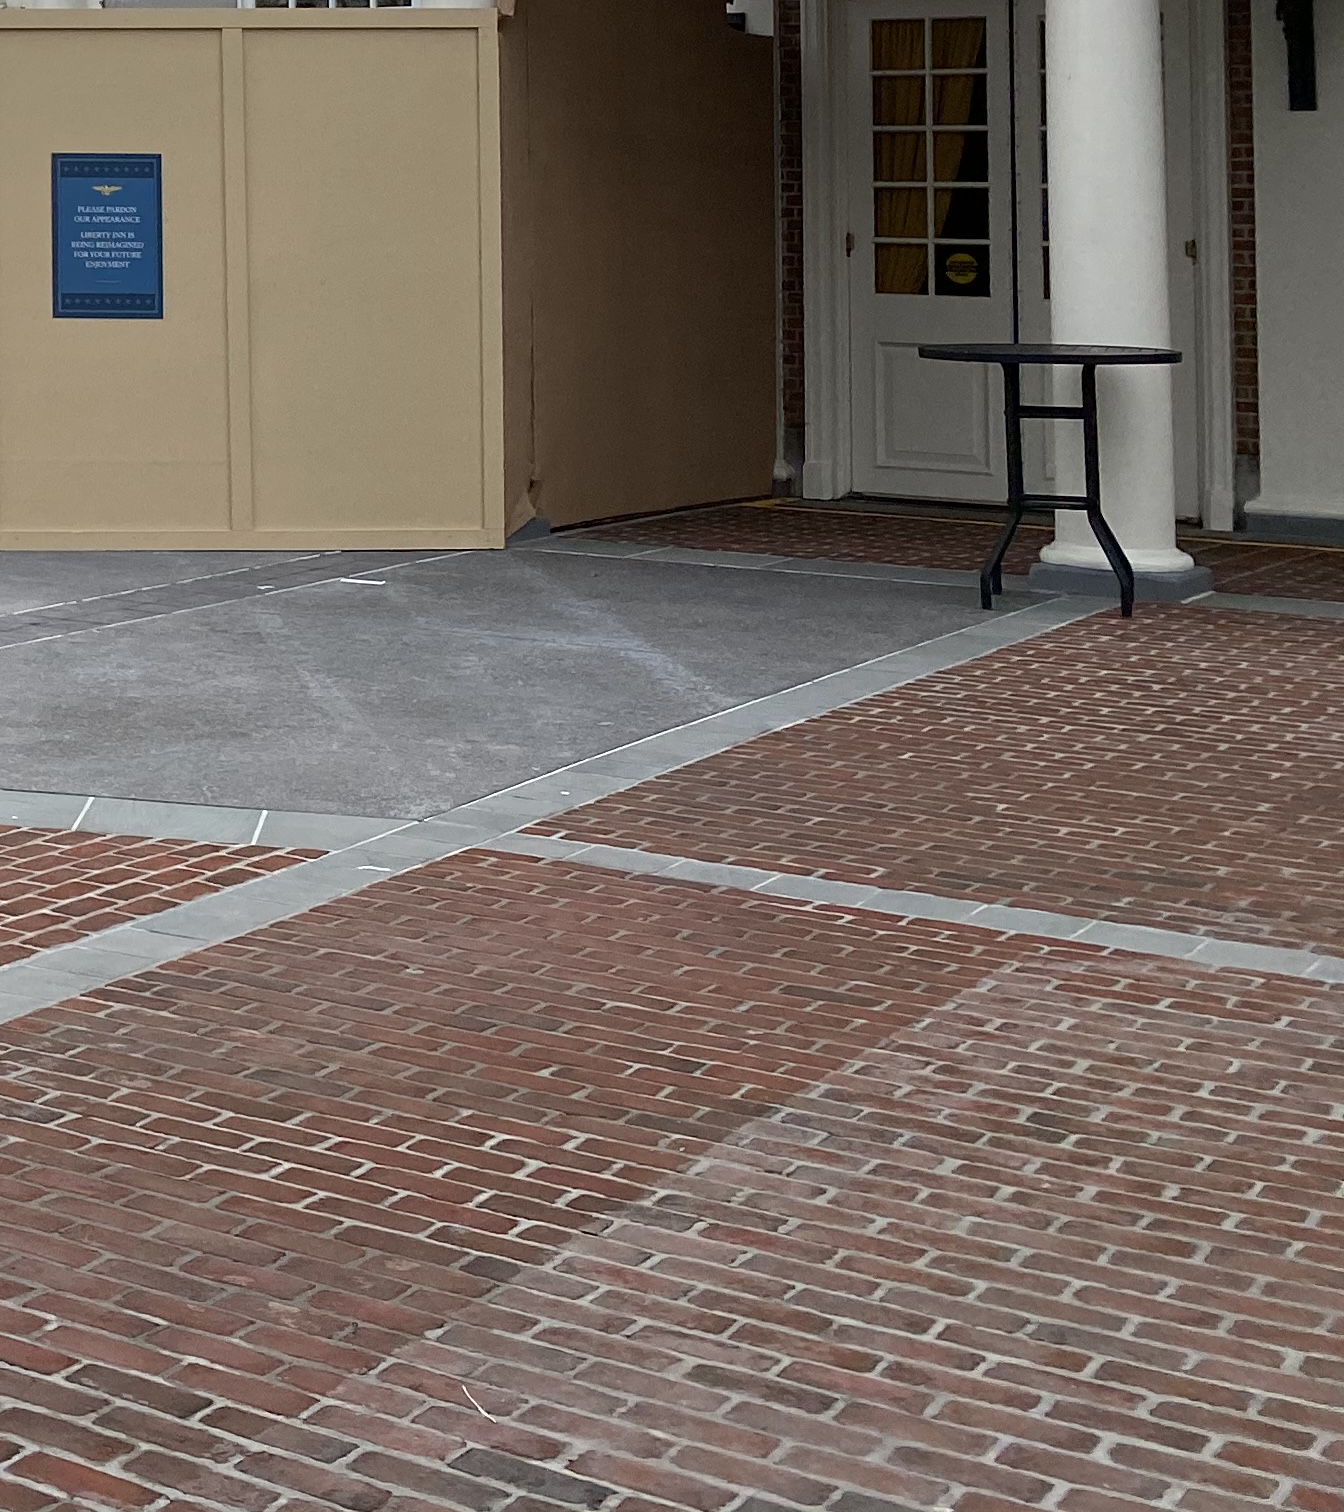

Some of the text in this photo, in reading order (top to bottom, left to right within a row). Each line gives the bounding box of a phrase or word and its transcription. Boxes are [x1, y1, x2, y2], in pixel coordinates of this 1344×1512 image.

[77, 205, 105, 213] PLEASE
[73, 215, 141, 223] OUR APPEARANCE
[80, 231, 112, 239] LIBERTY
[112, 231, 127, 239] INN
[96, 241, 145, 249] REIMAGINED
[111, 251, 142, 259] FUTURE
[85, 260, 131, 269] ENJOYMENT
